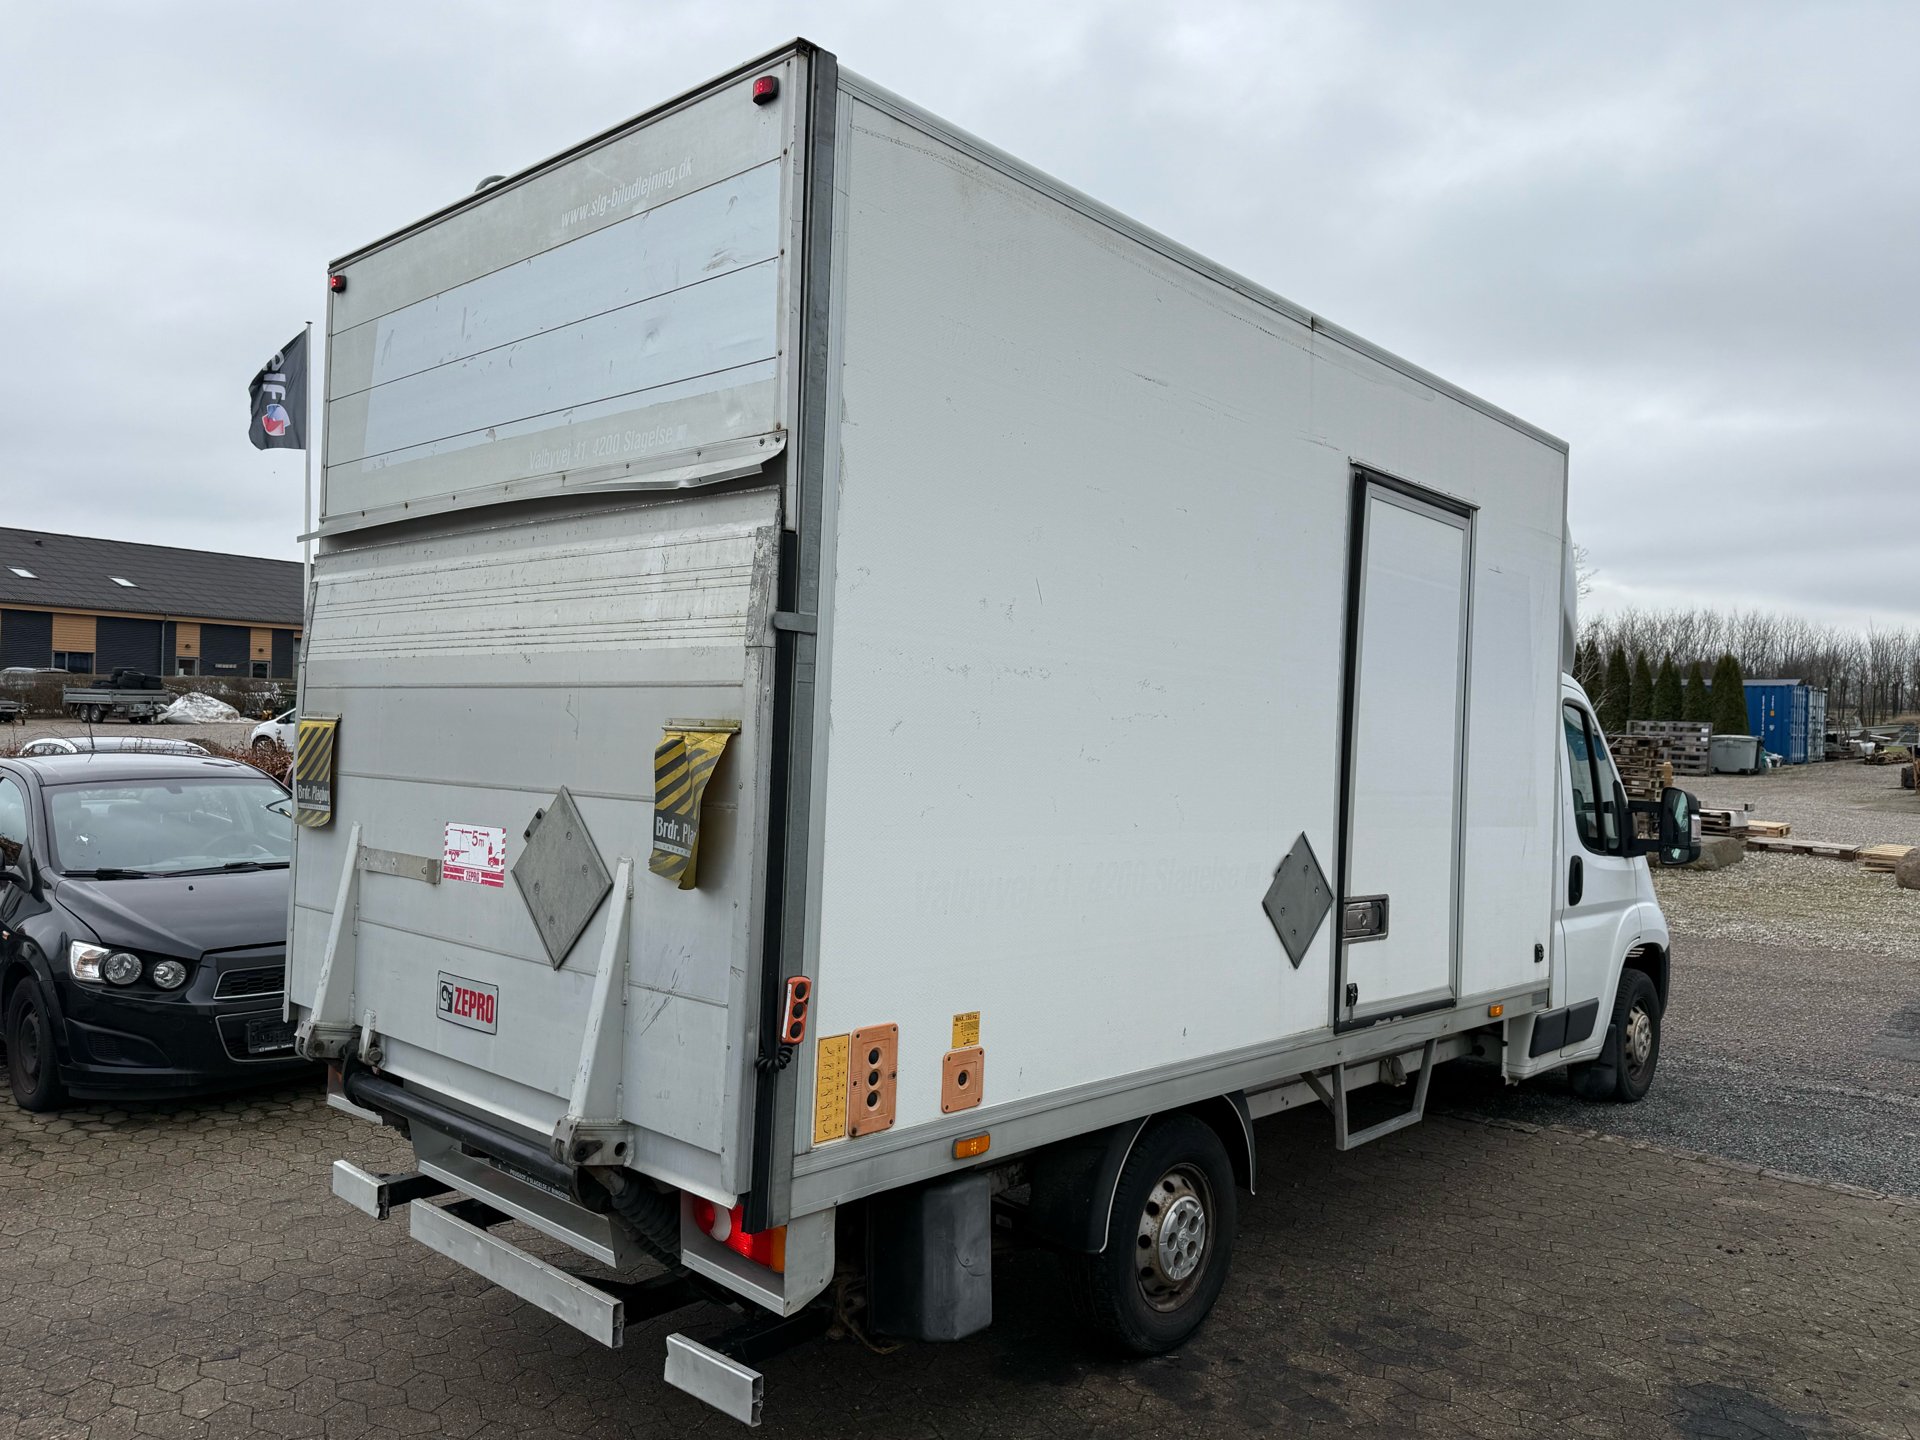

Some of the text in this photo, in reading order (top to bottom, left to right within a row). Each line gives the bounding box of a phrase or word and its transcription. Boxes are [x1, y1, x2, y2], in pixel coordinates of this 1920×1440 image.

[561, 156, 692, 228] www.slg-biludlejning.dk
[529, 442, 571, 470] Valbyvej
[593, 433, 620, 457] 4200
[623, 425, 673, 453] Slagelse
[656, 816, 680, 842] Brdr.
[1088, 857, 1148, 903] 4200
[454, 986, 494, 1024] ZEPRO
